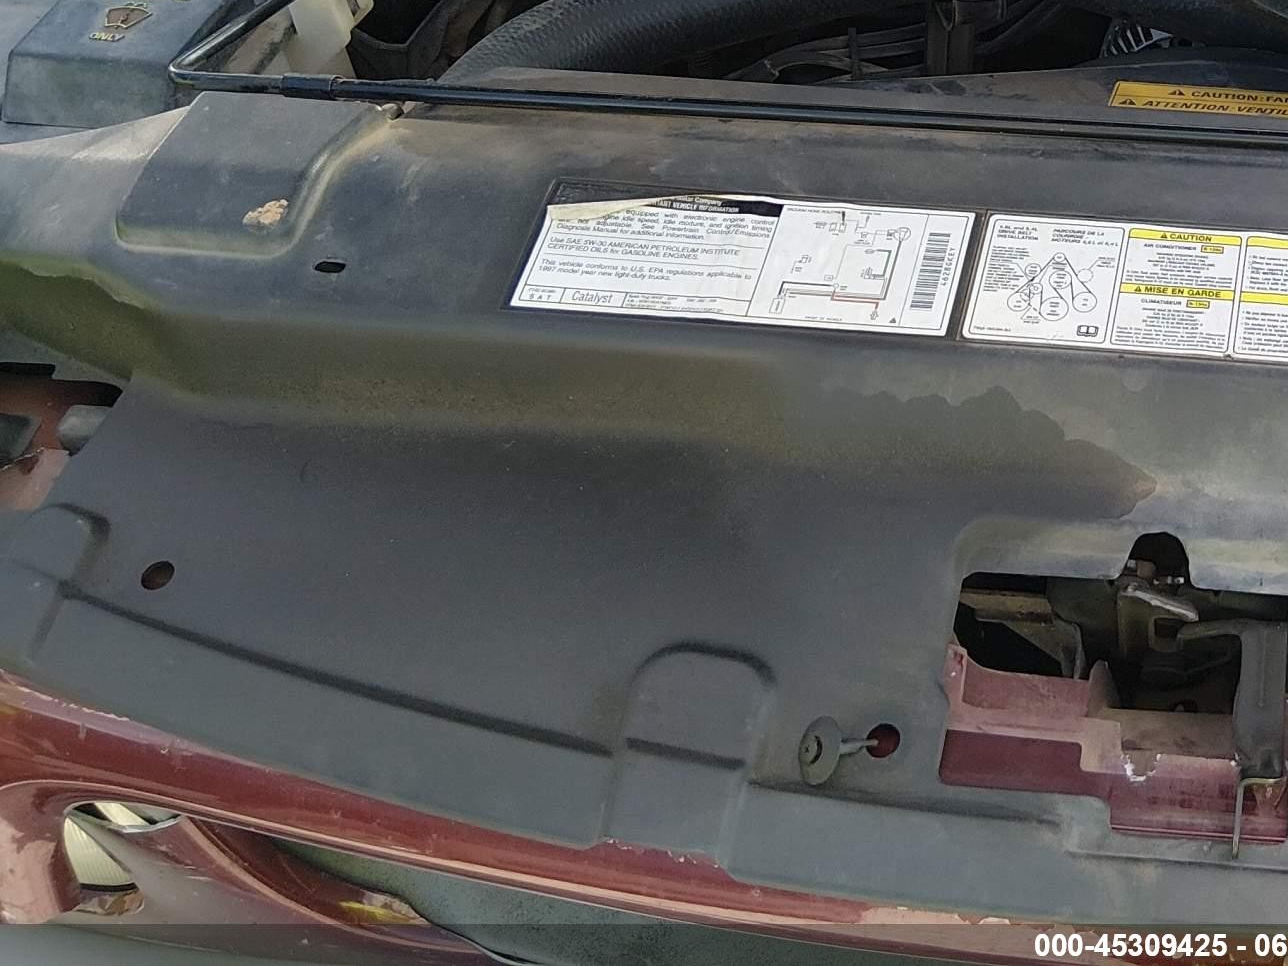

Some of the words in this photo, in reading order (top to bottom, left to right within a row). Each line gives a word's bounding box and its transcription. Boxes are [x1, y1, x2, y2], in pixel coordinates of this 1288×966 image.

[88, 31, 126, 42] ONLY
[1142, 100, 1229, 112] ATTENTION
[672, 201, 698, 210] VEHICLE
[556, 223, 591, 232] Diagnosis
[592, 225, 619, 233] Manual
[706, 227, 771, 238] Control/Emissions
[751, 224, 773, 233] timing
[1169, 233, 1212, 242] CAUTION
[547, 243, 589, 252] CERTIFIED
[621, 248, 662, 258] GASOLINE
[566, 237, 581, 245] SAE
[583, 239, 607, 247] 5W-30
[607, 240, 650, 250] AMERICAN
[650, 244, 700, 254] PETROLEUM
[700, 248, 741, 256] INSTITUTE
[542, 258, 556, 266] This
[558, 260, 584, 268] vehicle
[585, 261, 619, 270] conforms
[666, 269, 704, 277] regulations
[706, 271, 742, 279] applicable
[580, 268, 597, 276] year
[614, 270, 647, 280] light-duty
[571, 291, 613, 304] Catalyst
[1144, 286, 1169, 294] MISE
[1187, 289, 1221, 298] GARDE
[1140, 298, 1182, 306] CLIMATISEUR
